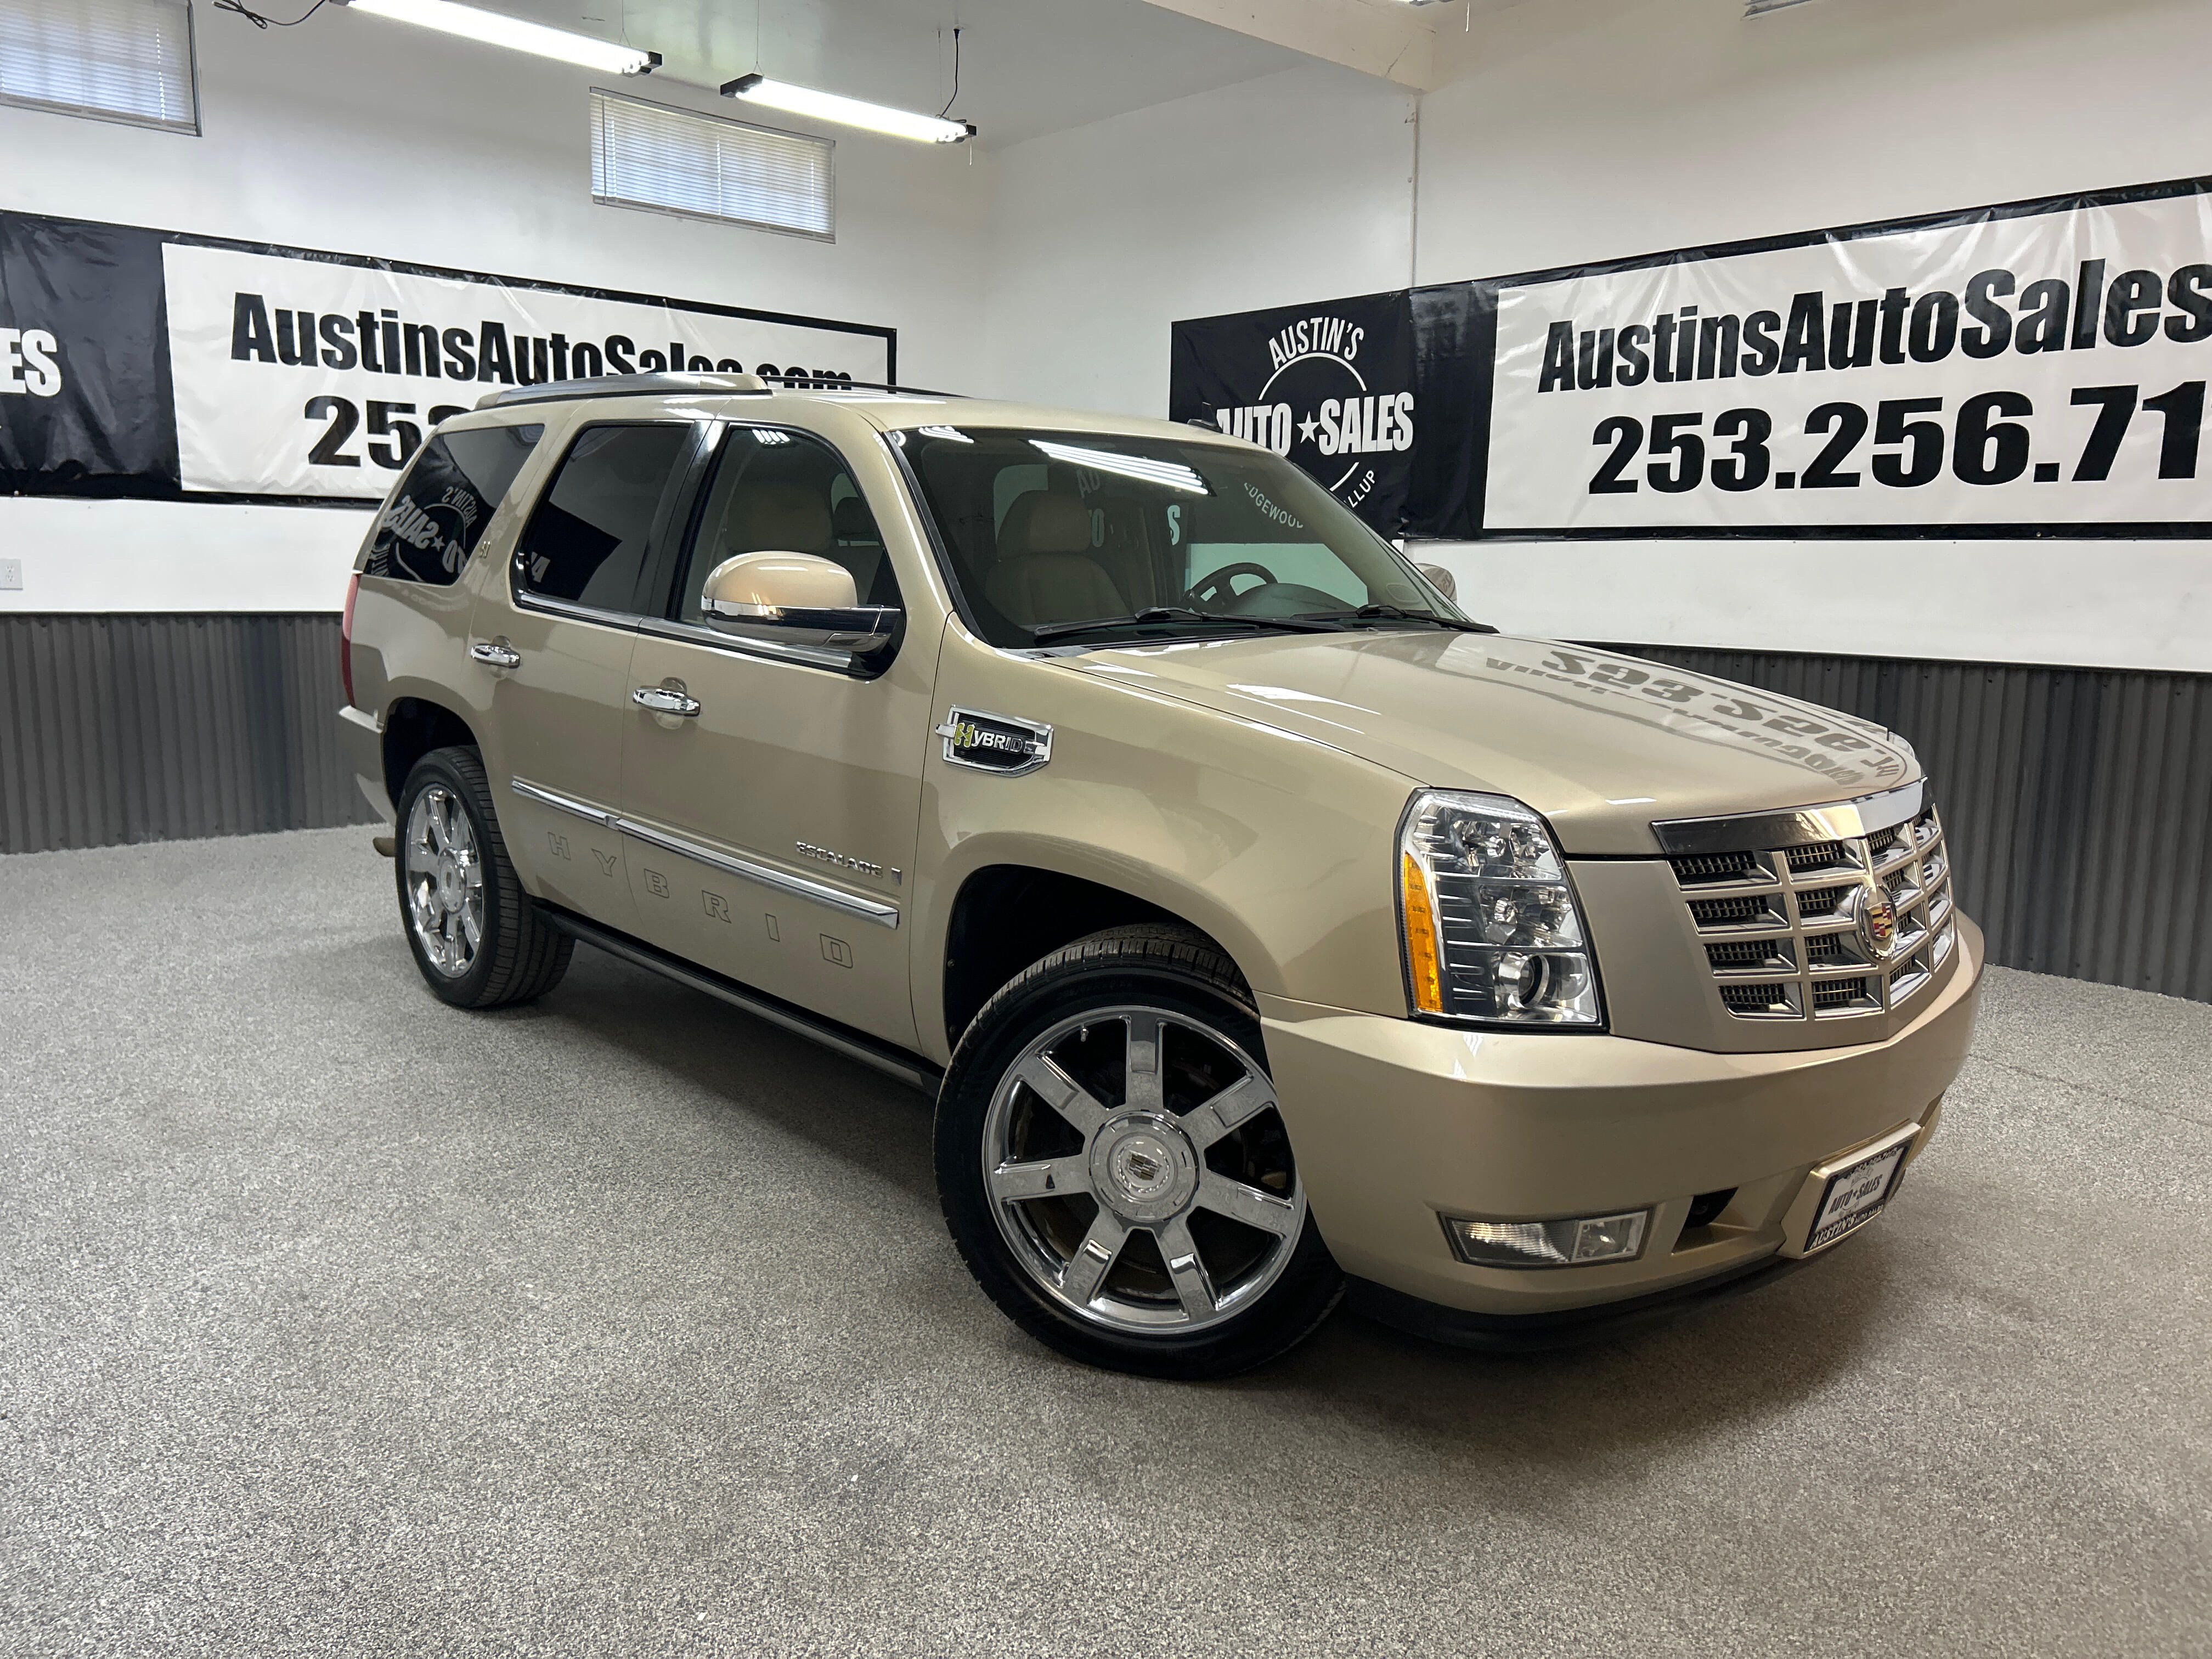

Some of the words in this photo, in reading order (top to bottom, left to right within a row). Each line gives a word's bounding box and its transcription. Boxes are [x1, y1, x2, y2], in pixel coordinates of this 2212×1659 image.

[230, 292, 852, 390] AustinsAutoSalom
[1268, 317, 1364, 370] AUSTIN'S
[1538, 258, 2212, 393] AustinsAutoSales
[304, 395, 471, 470] 25
[1319, 392, 1414, 455] SALES
[1589, 381, 2212, 495] 253.256.71
[1344, 470, 1375, 508] LLUP
[797, 841, 883, 878] ESCALADE
[549, 832, 854, 969] HYBRID
[1828, 1189, 1854, 1215] AUTO
[1856, 1174, 1883, 1200] SALES
